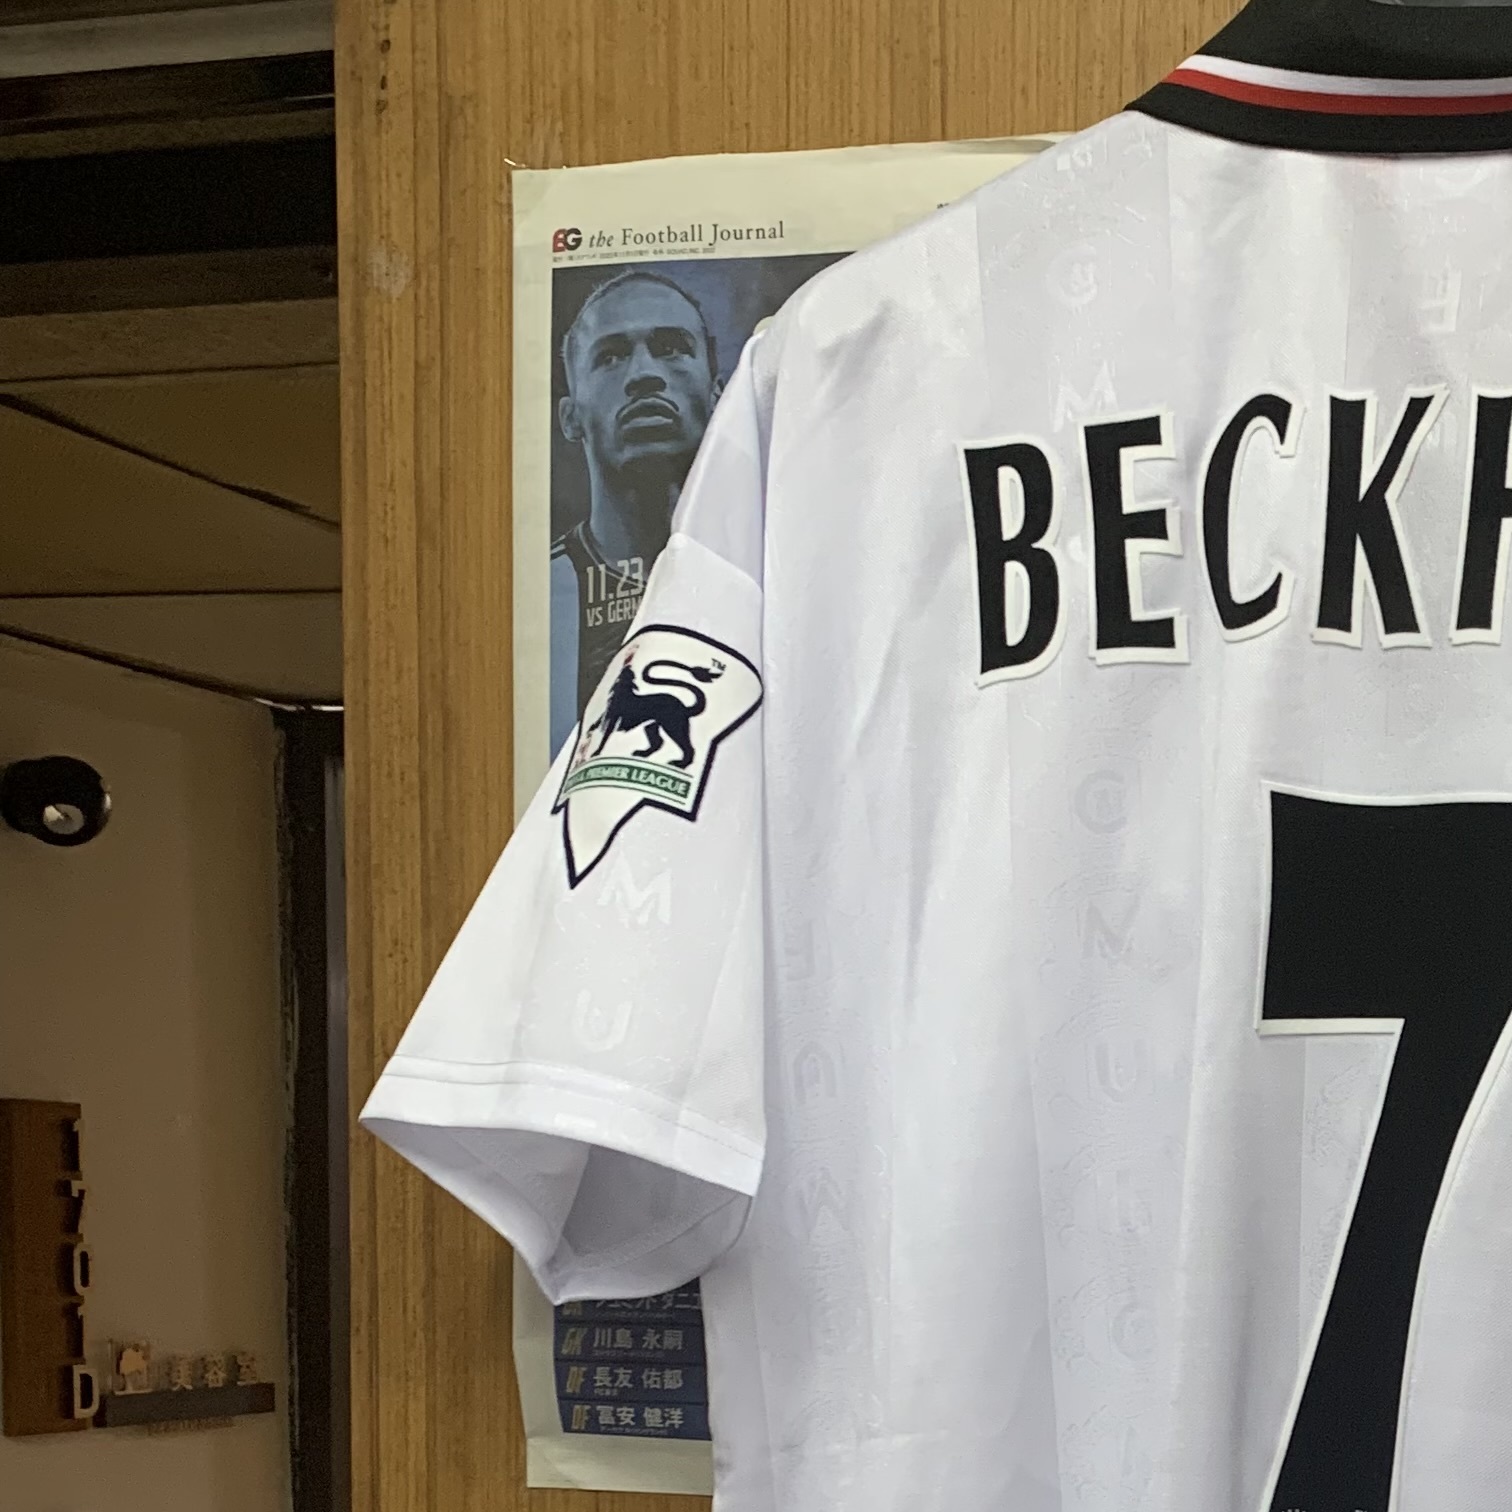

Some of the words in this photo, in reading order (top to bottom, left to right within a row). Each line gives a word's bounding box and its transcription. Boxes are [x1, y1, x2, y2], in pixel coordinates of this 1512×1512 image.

[588, 230, 614, 248] the
[620, 222, 703, 246] Football
[708, 220, 784, 246] Journal
[585, 556, 644, 604] 11.23
[586, 606, 604, 628] VS
[631, 768, 687, 795] LEAGUE
[593, 1366, 634, 1389] 長友
